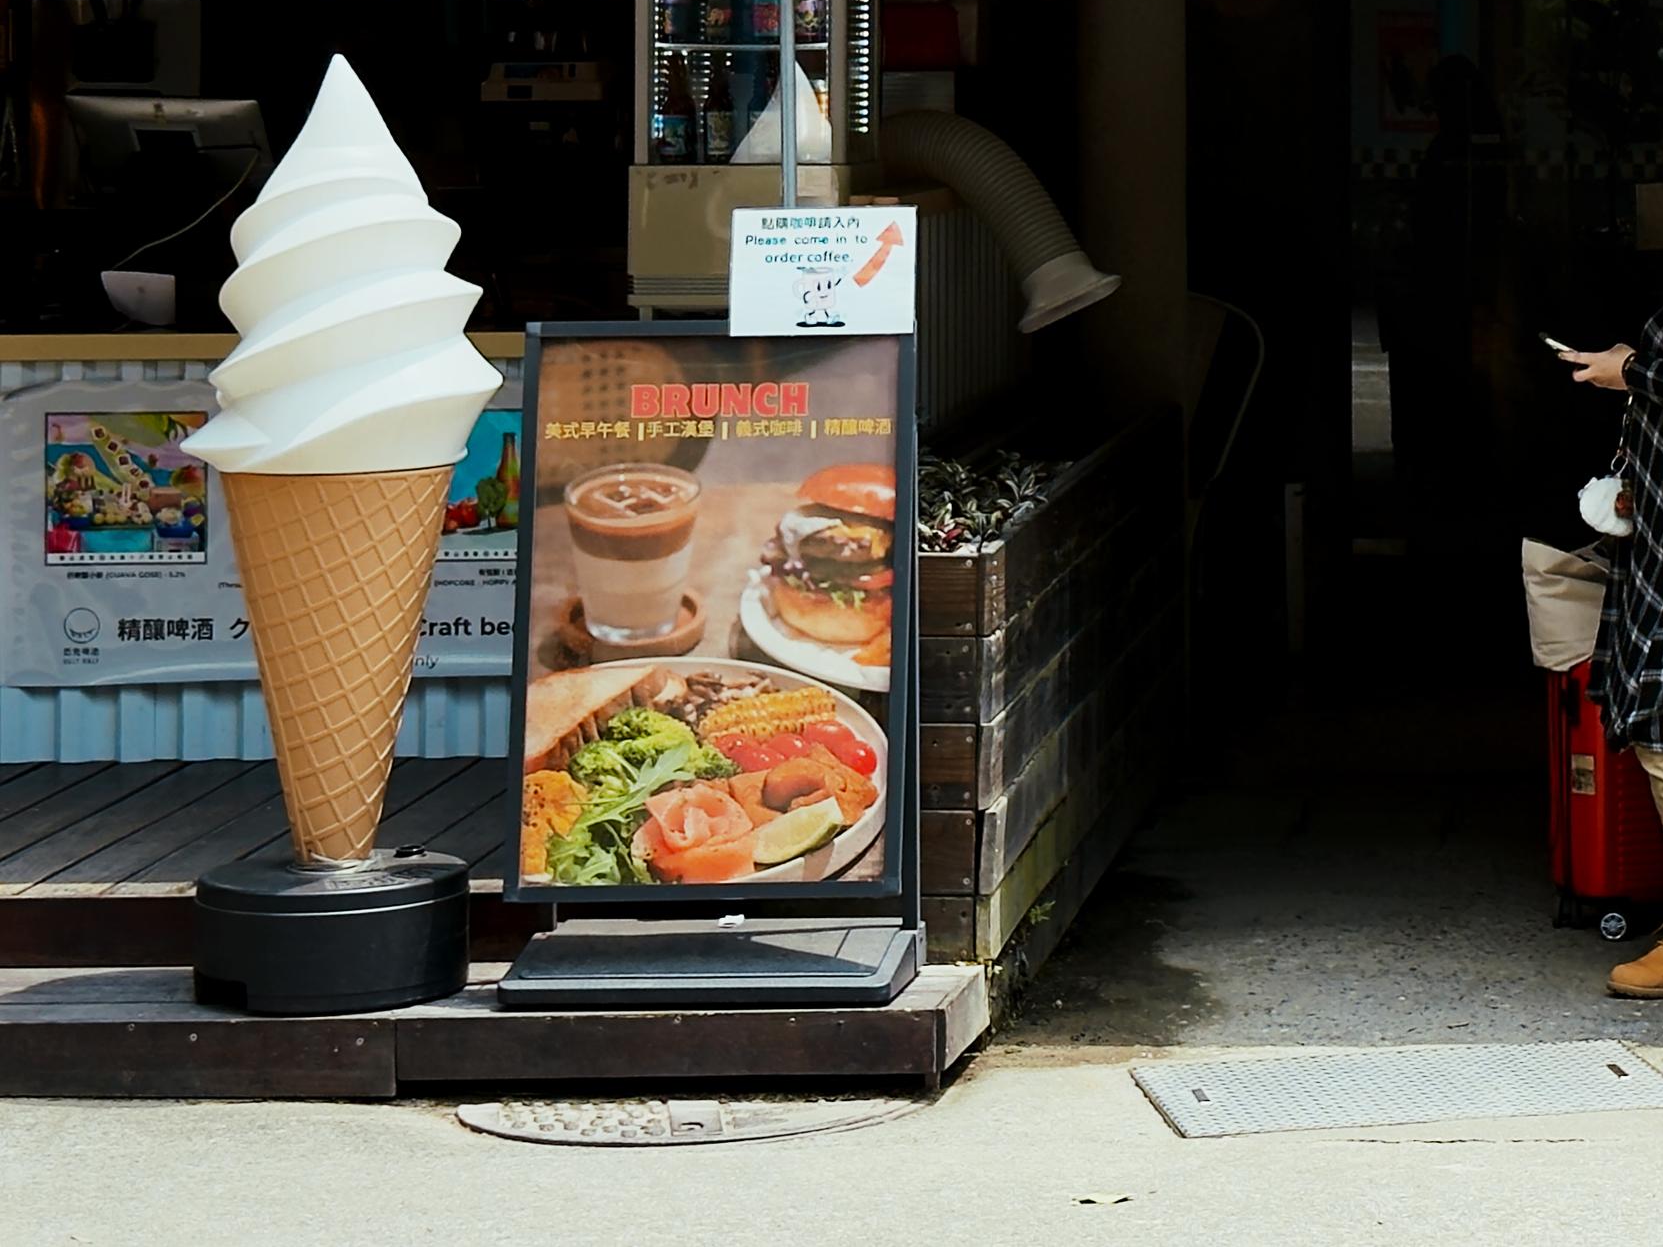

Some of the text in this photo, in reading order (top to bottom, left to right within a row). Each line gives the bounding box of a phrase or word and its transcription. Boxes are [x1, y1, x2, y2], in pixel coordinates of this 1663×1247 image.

[745, 234, 868, 246] Please come in to
[765, 250, 853, 263] order coffee.
[630, 382, 809, 419] BRUNCH
[544, 417, 892, 440] 美式早午餐 手工漢堡 義式咖啡 精釀啤酒
[118, 617, 214, 641] 精釀啤酒
[480, 617, 515, 635] be
[415, 655, 439, 670] nly
